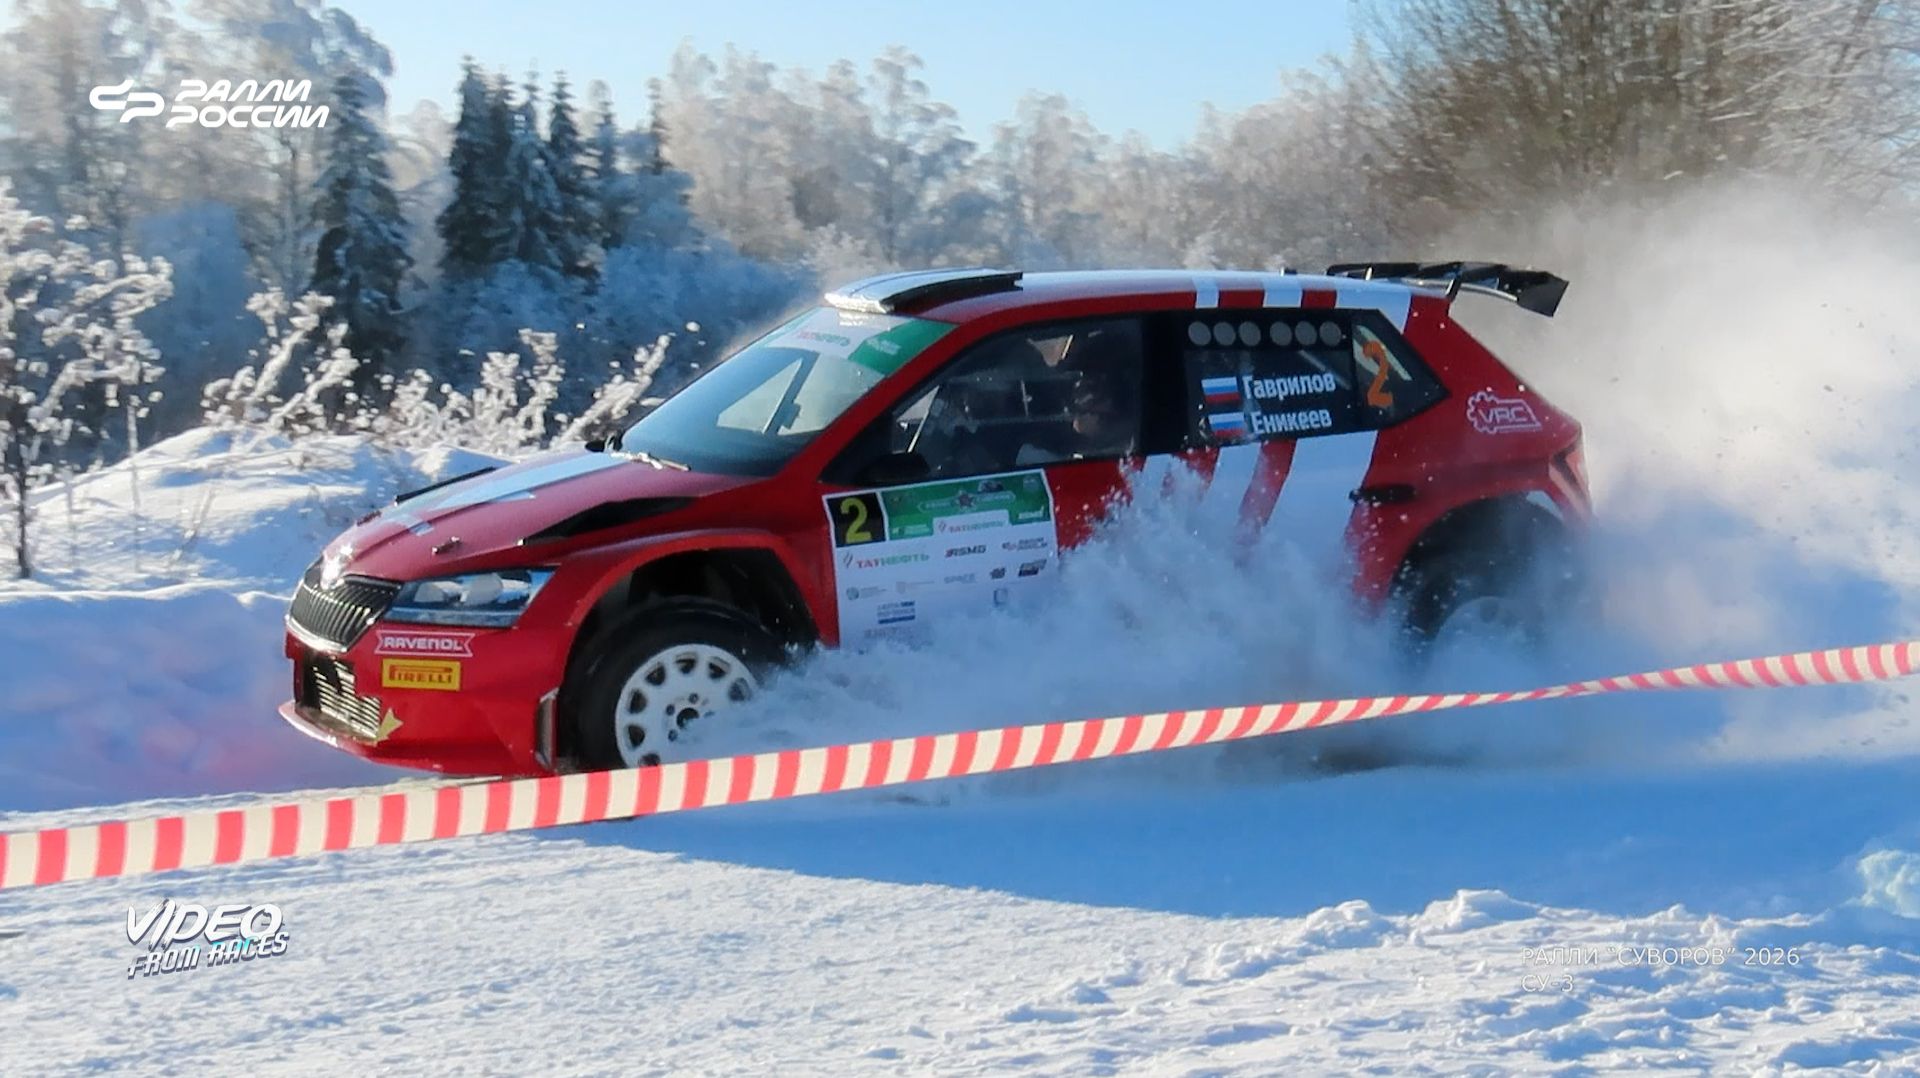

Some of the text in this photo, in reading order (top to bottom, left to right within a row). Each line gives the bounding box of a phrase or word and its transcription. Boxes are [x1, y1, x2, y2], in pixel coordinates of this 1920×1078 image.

[1242, 372, 1336, 402] Гаврилов
[1362, 339, 1393, 408] 2
[1250, 407, 1333, 436] Еникеев
[1477, 405, 1528, 424] VRC
[840, 497, 872, 543] 2
[383, 636, 464, 651] RAVENOL
[388, 664, 454, 684] PIRELLI
